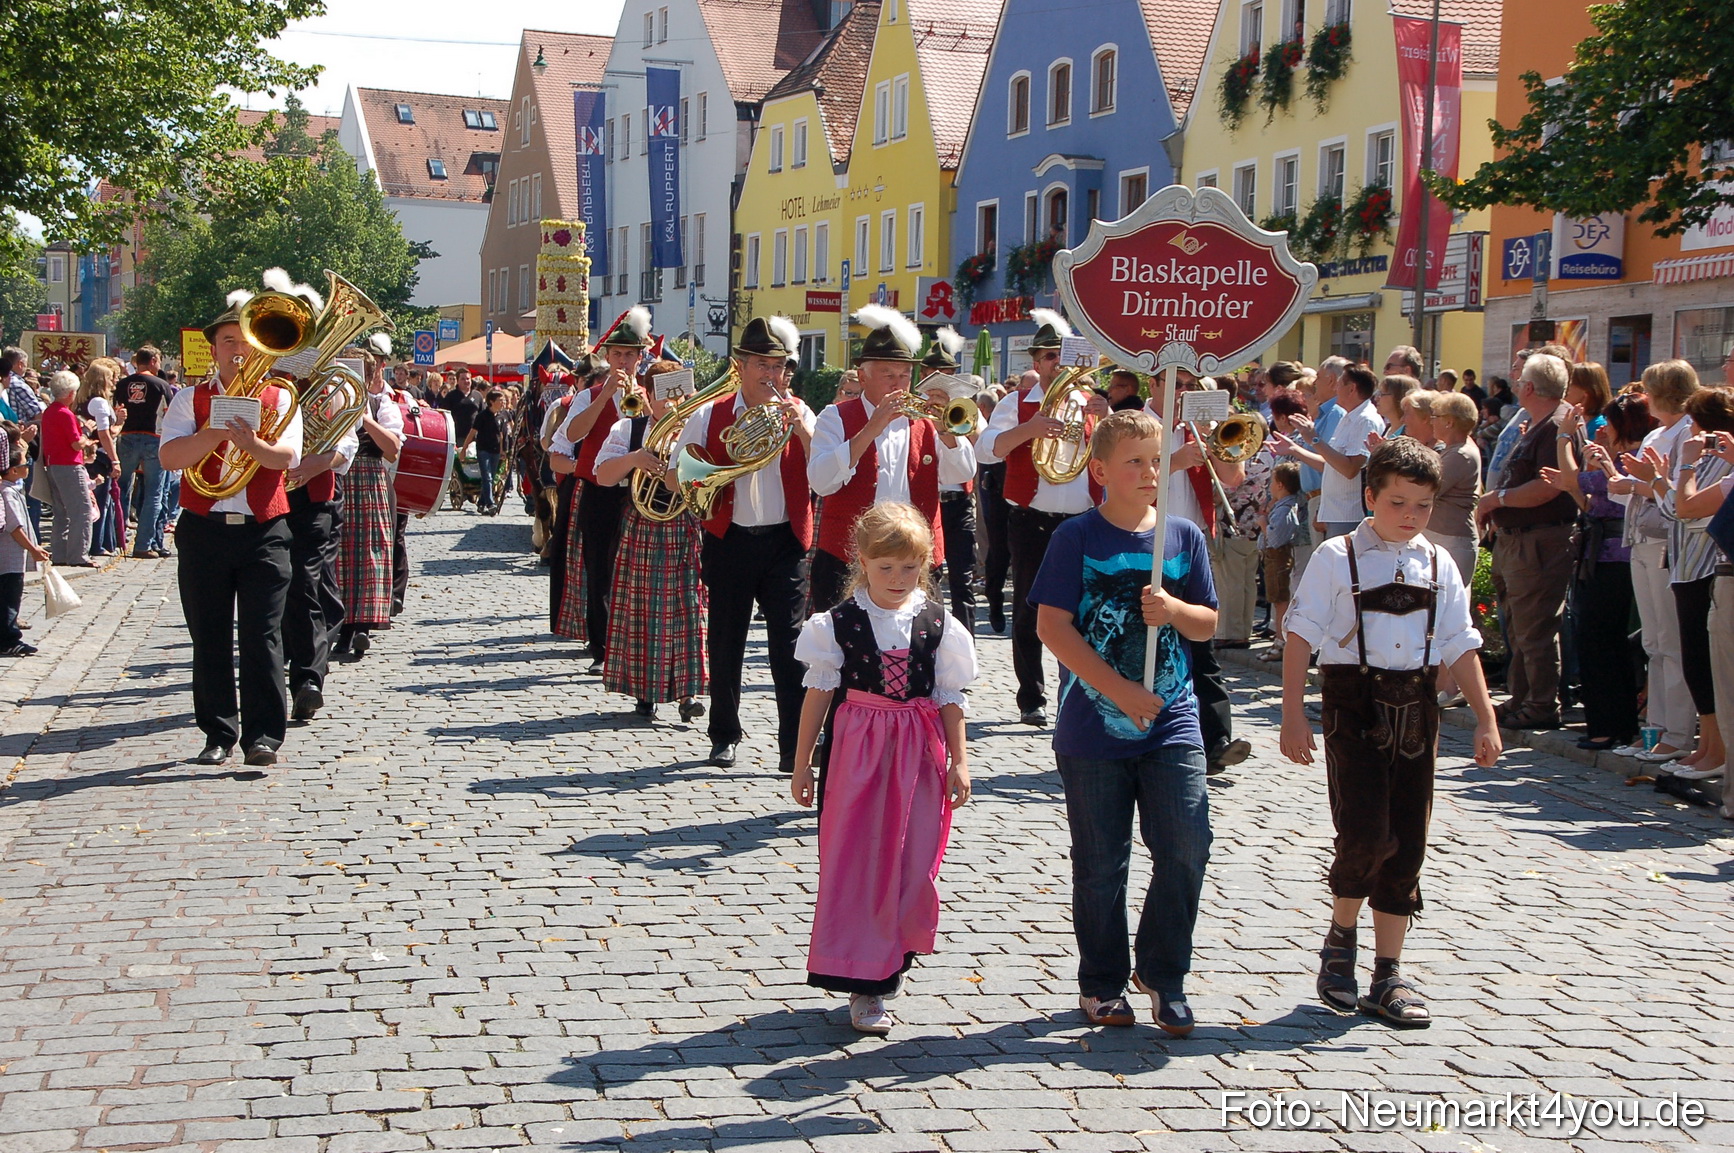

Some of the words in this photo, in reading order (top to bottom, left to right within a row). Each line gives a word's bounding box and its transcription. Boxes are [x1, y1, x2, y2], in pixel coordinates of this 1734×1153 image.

[664, 142, 675, 212] RUPPERT
[781, 196, 806, 221] HOTEL
[812, 193, 841, 214] Lehmeier
[665, 213, 675, 243] K&L
[1110, 256, 1268, 291] Blaskapelle
[1470, 236, 1481, 305] KINO
[1561, 263, 1618, 275] Reisebüro
[807, 297, 841, 306] WISSMACH
[1121, 290, 1254, 319] Dirnhofer
[777, 310, 811, 325] aurant
[1164, 323, 1201, 342] Stauf
[416, 353, 434, 363] TAXI
